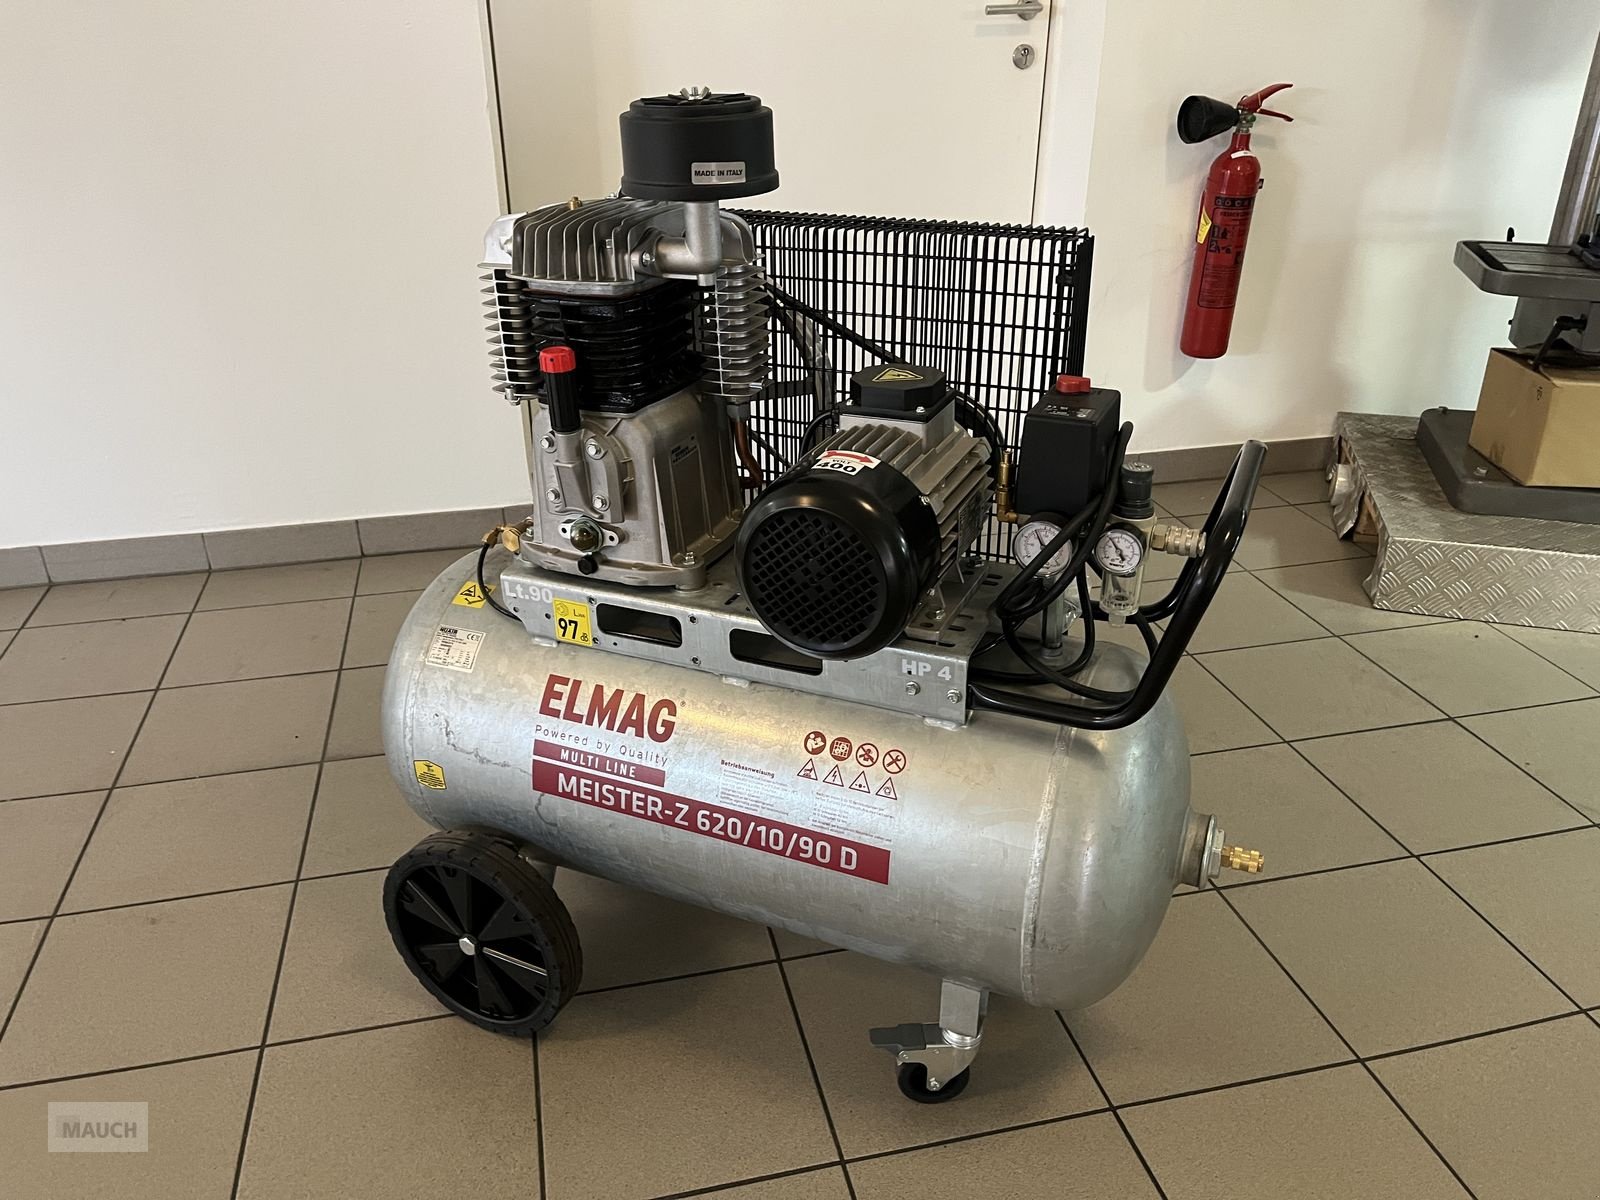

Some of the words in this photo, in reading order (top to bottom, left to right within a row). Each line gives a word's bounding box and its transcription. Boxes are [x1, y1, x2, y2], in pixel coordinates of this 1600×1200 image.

[694, 169, 716, 177] MADE
[726, 168, 744, 176] ITALY
[816, 462, 857, 473] 400
[503, 580, 553, 604] Lt.90
[558, 617, 579, 640] 97
[901, 659, 932, 677] HP
[937, 666, 952, 681] 4
[535, 724, 589, 746] Powered
[596, 739, 611, 752] by
[619, 744, 668, 767] Quality
[560, 748, 599, 769] MULTI
[605, 759, 636, 778] LINE
[720, 759, 775, 779] Betriebsanweisung
[558, 772, 690, 827] MEISTER-Z
[696, 810, 831, 864] 620/10/90
[839, 846, 858, 871] D
